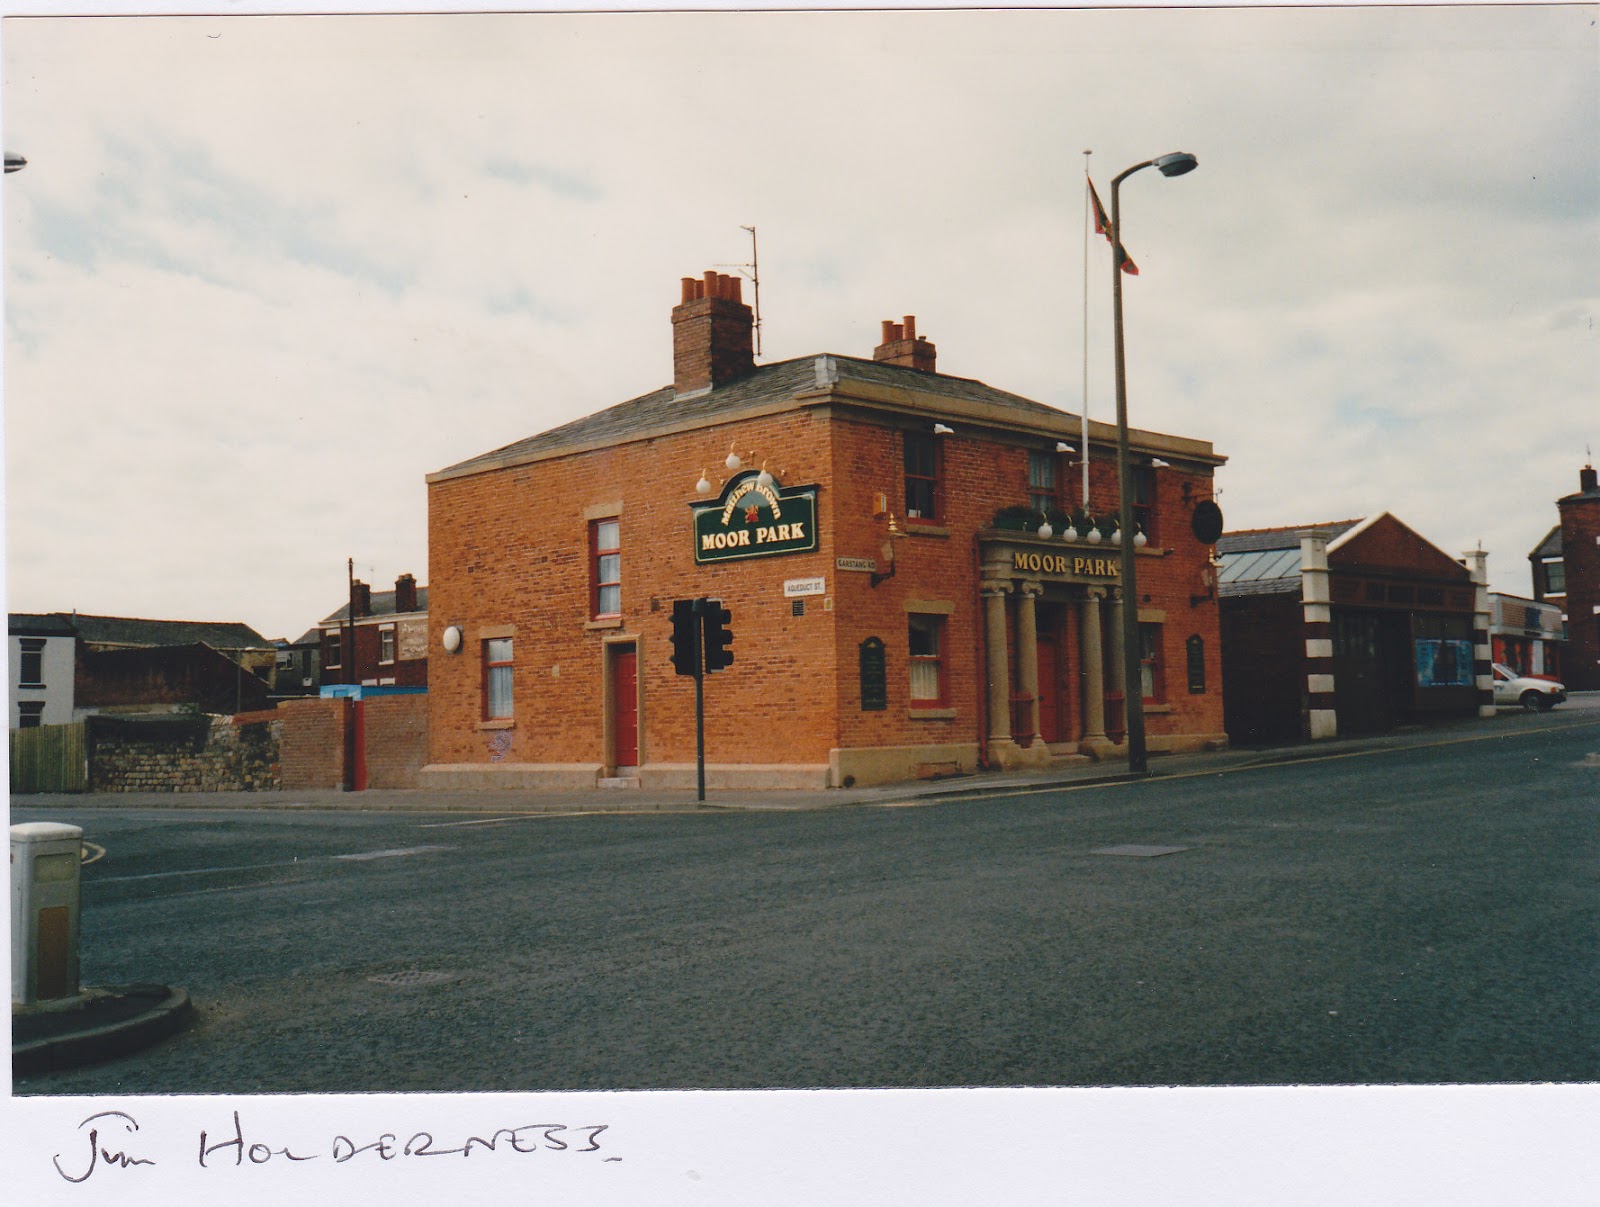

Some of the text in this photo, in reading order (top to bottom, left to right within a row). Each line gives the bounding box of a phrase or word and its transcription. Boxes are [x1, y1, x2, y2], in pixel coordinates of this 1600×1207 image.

[702, 522, 805, 550] MOOR PARK
[838, 559, 866, 568] GARSTANG
[1014, 552, 1119, 576] MOOR PARK
[787, 582, 813, 592] AQUEDUCT
[53, 1110, 156, 1183] Jim
